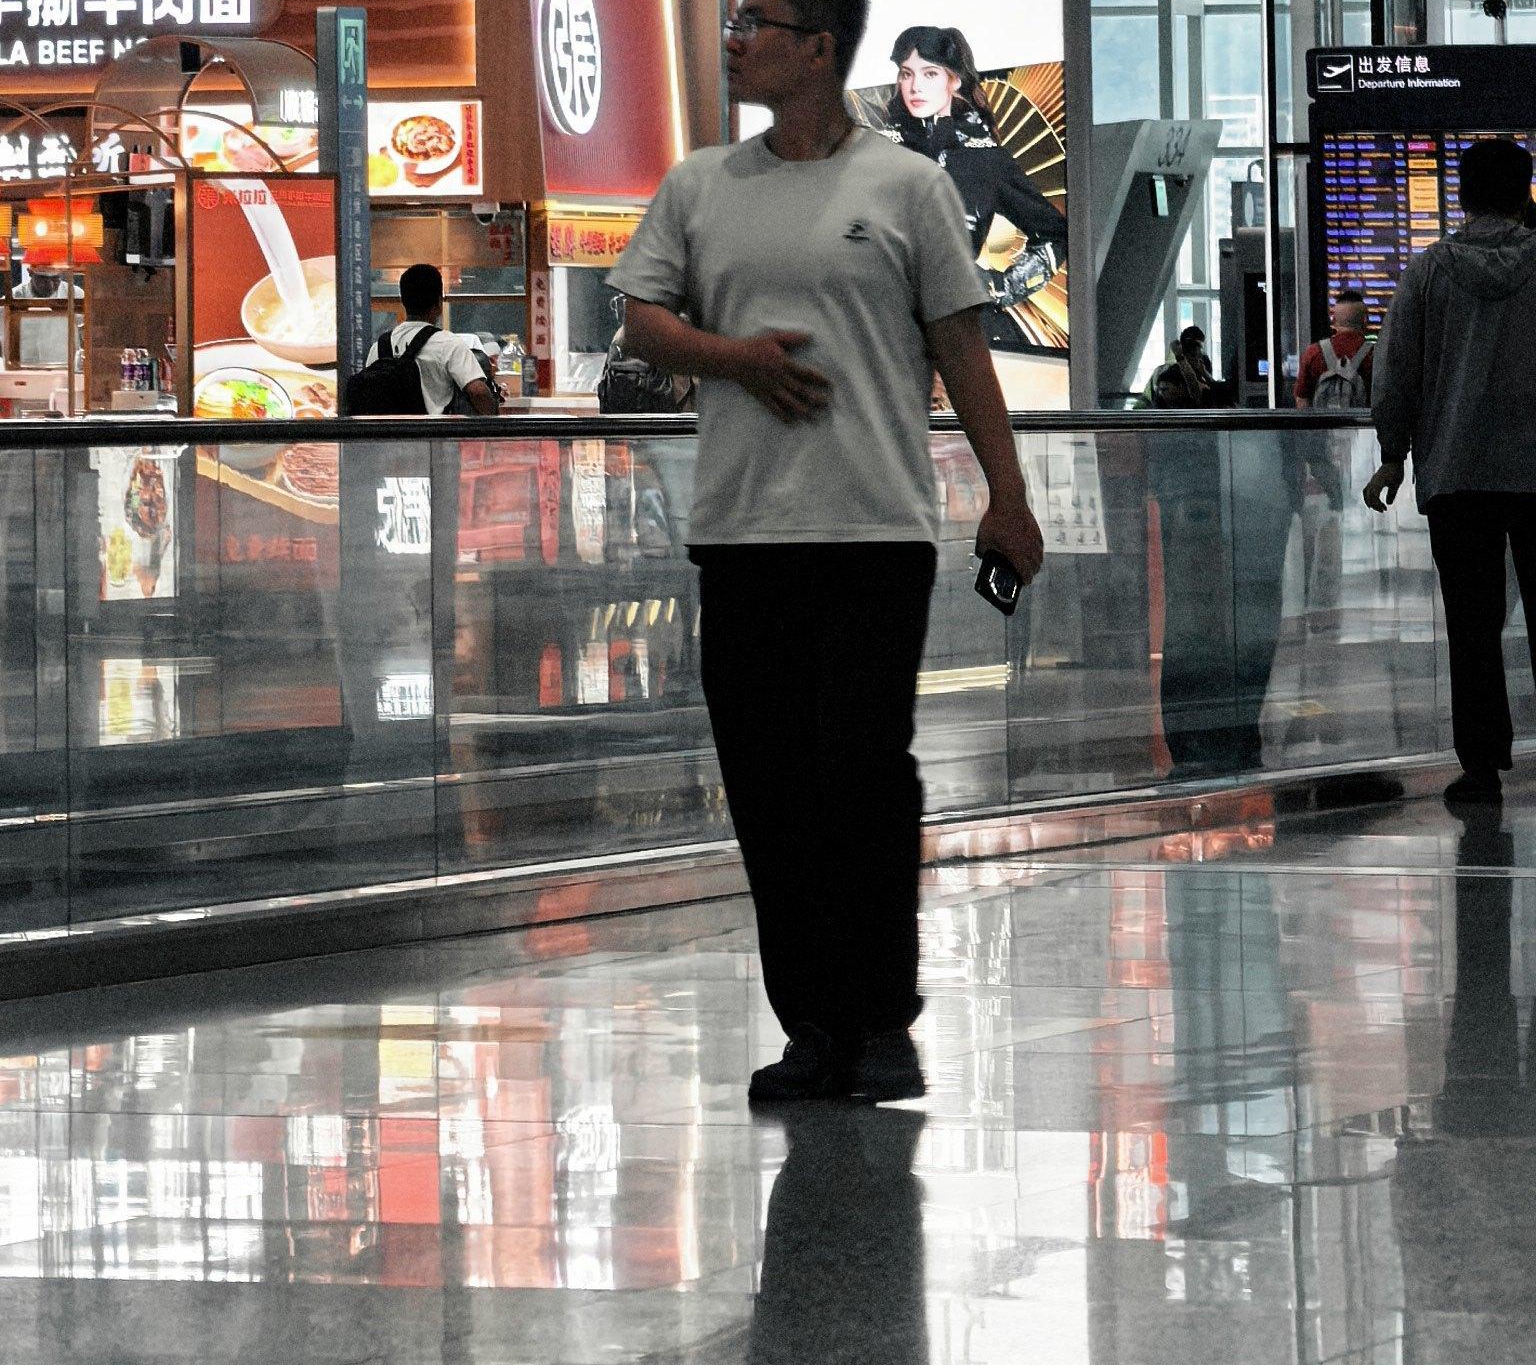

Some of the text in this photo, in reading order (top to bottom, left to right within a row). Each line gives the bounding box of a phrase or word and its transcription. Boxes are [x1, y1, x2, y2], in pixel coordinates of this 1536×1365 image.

[38, 39, 104, 65] BEEF
[1358, 55, 1431, 74] 出发信息
[1358, 77, 1461, 90] Departure Information
